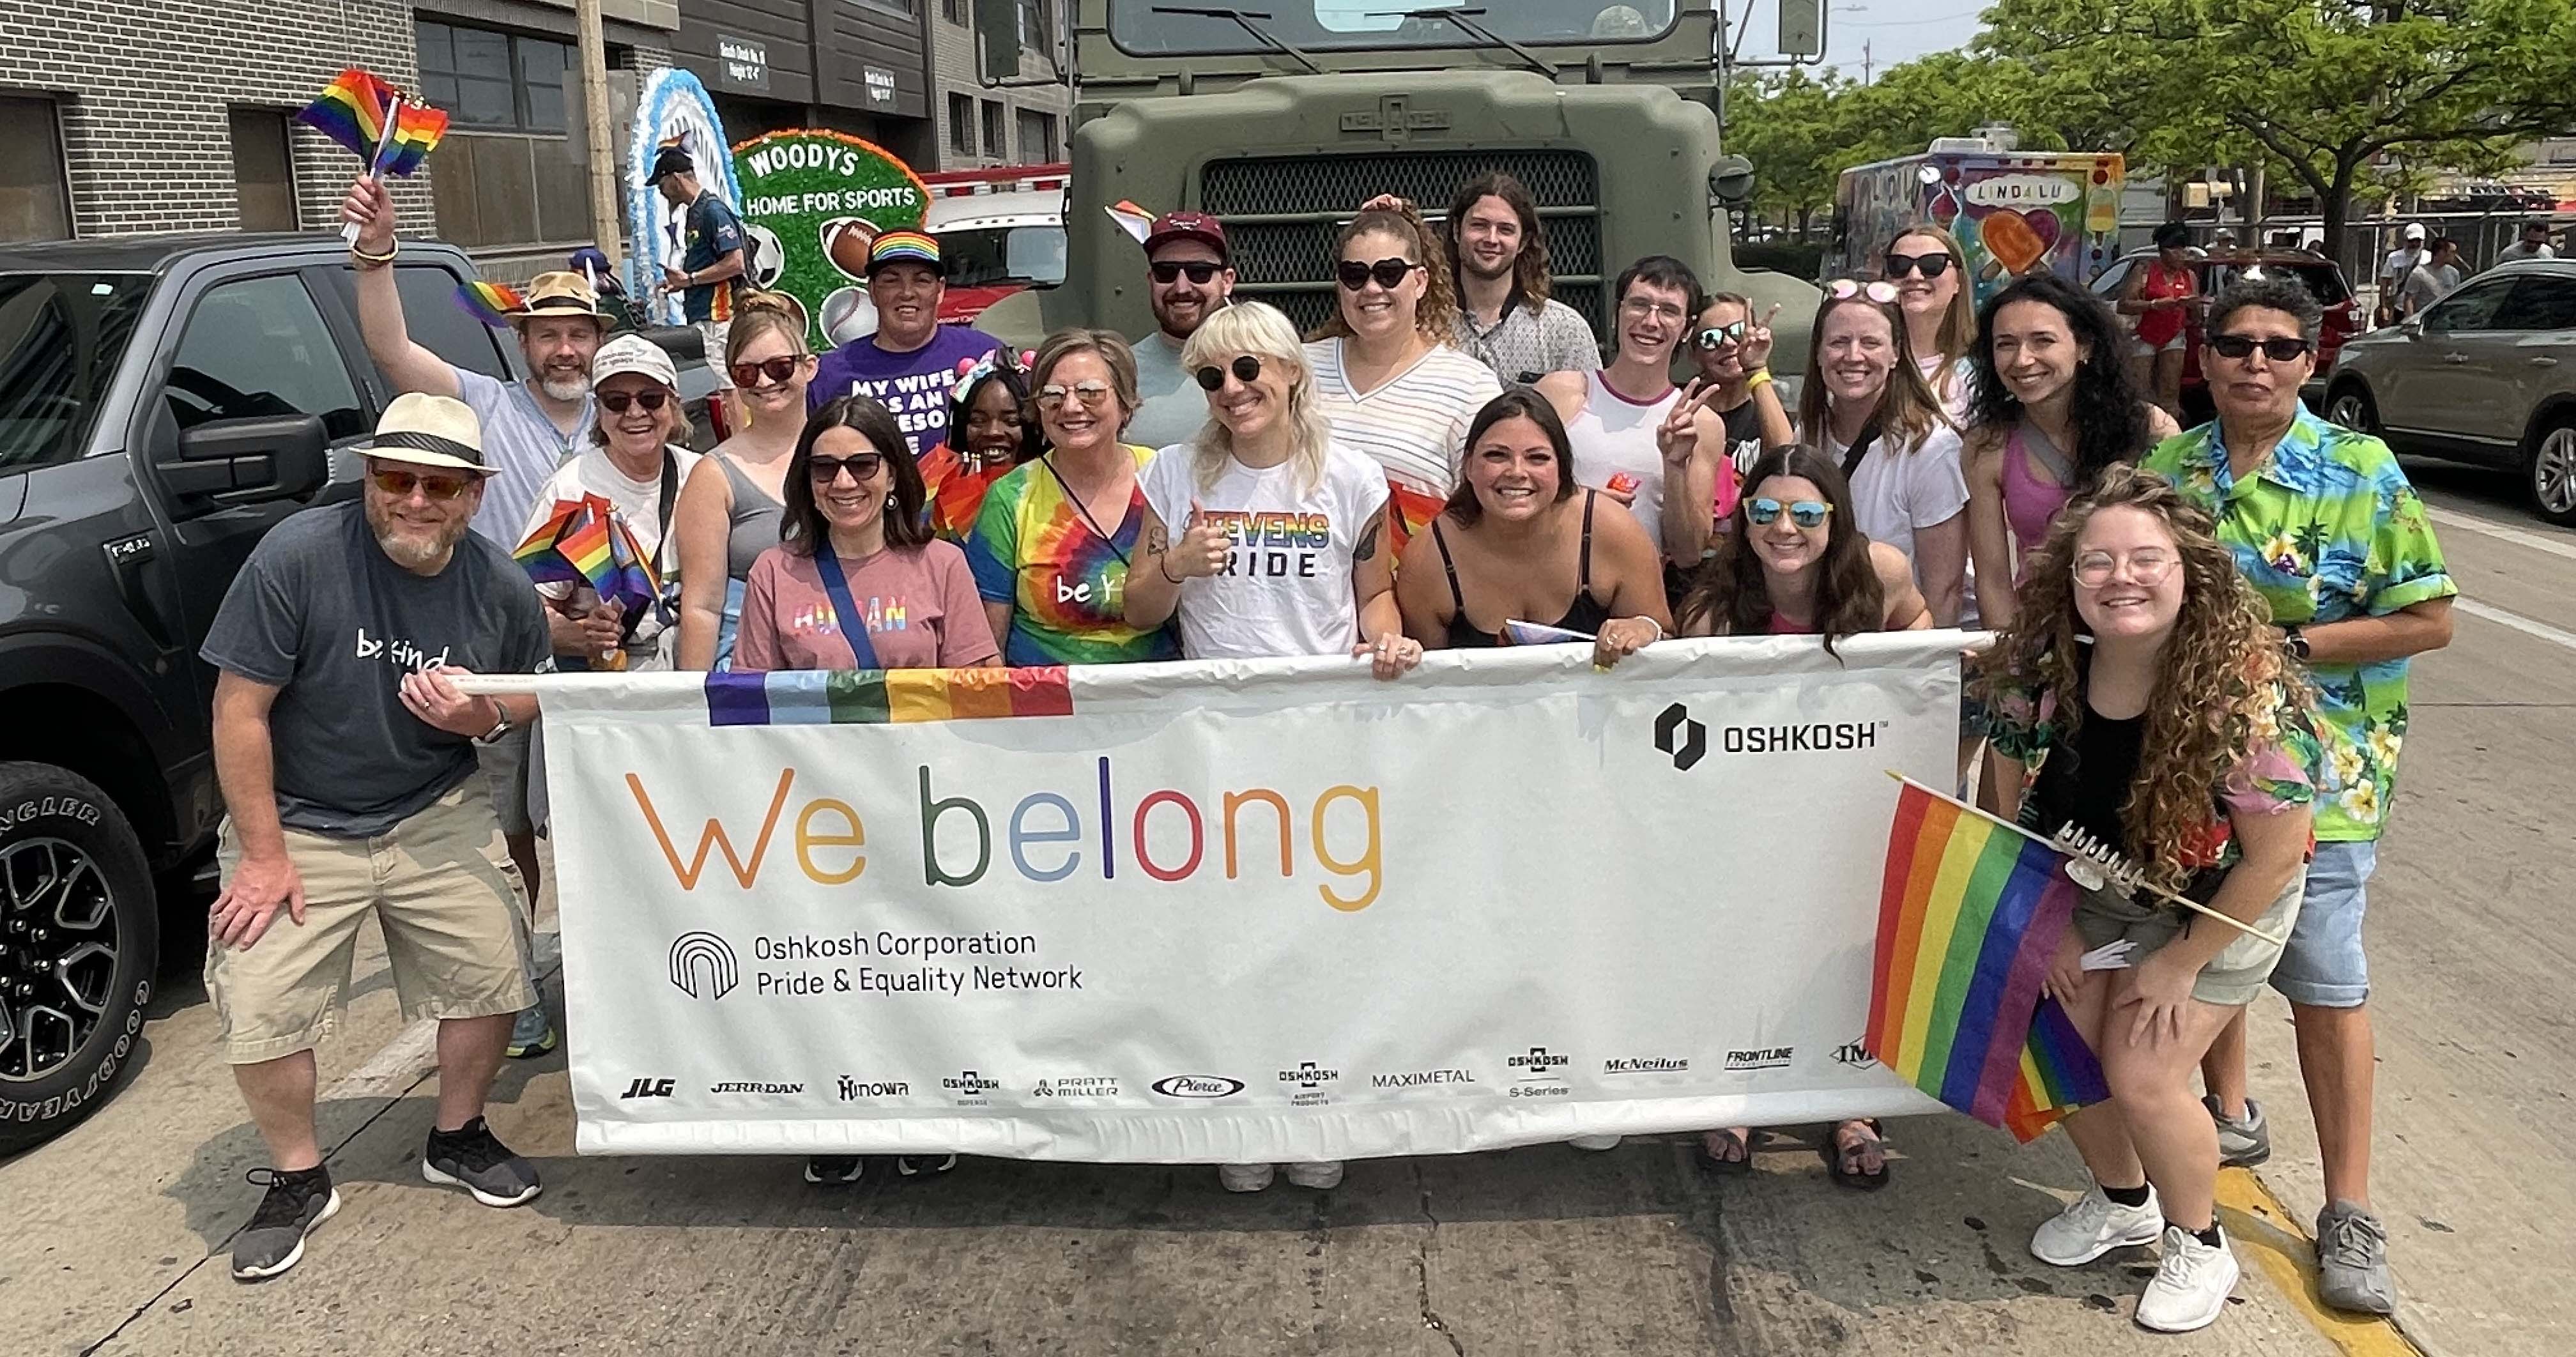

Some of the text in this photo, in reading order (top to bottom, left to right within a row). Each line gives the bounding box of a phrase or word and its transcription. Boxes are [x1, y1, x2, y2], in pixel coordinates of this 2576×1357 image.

[747, 144, 859, 178] WOODY'S
[746, 187, 916, 216] HOME FOR SPORTS
[852, 369, 956, 397] MY WIFE
[909, 390, 944, 410] AN
[1184, 510, 1330, 548] TEVENS
[1218, 551, 1316, 578] RIDE
[1057, 574, 1092, 603] be
[794, 595, 907, 636] HUAN
[356, 627, 384, 659] be
[625, 756, 1381, 912] We belong
[755, 930, 1036, 960] Oshkosh Corporation
[758, 965, 1083, 996] Pride & Equality Network
[1604, 1058, 1688, 1072] McNeilus
[1726, 1047, 1793, 1061] FRONTLINE
[620, 1078, 675, 1099] JLG
[1058, 1077, 1119, 1087] PRATT
[1058, 1087, 1119, 1096] MILLER
[1172, 1078, 1224, 1094] Pierce
[1372, 1070, 1476, 1087] MAXIMETAL
[1509, 1086, 1570, 1097] S-Series
